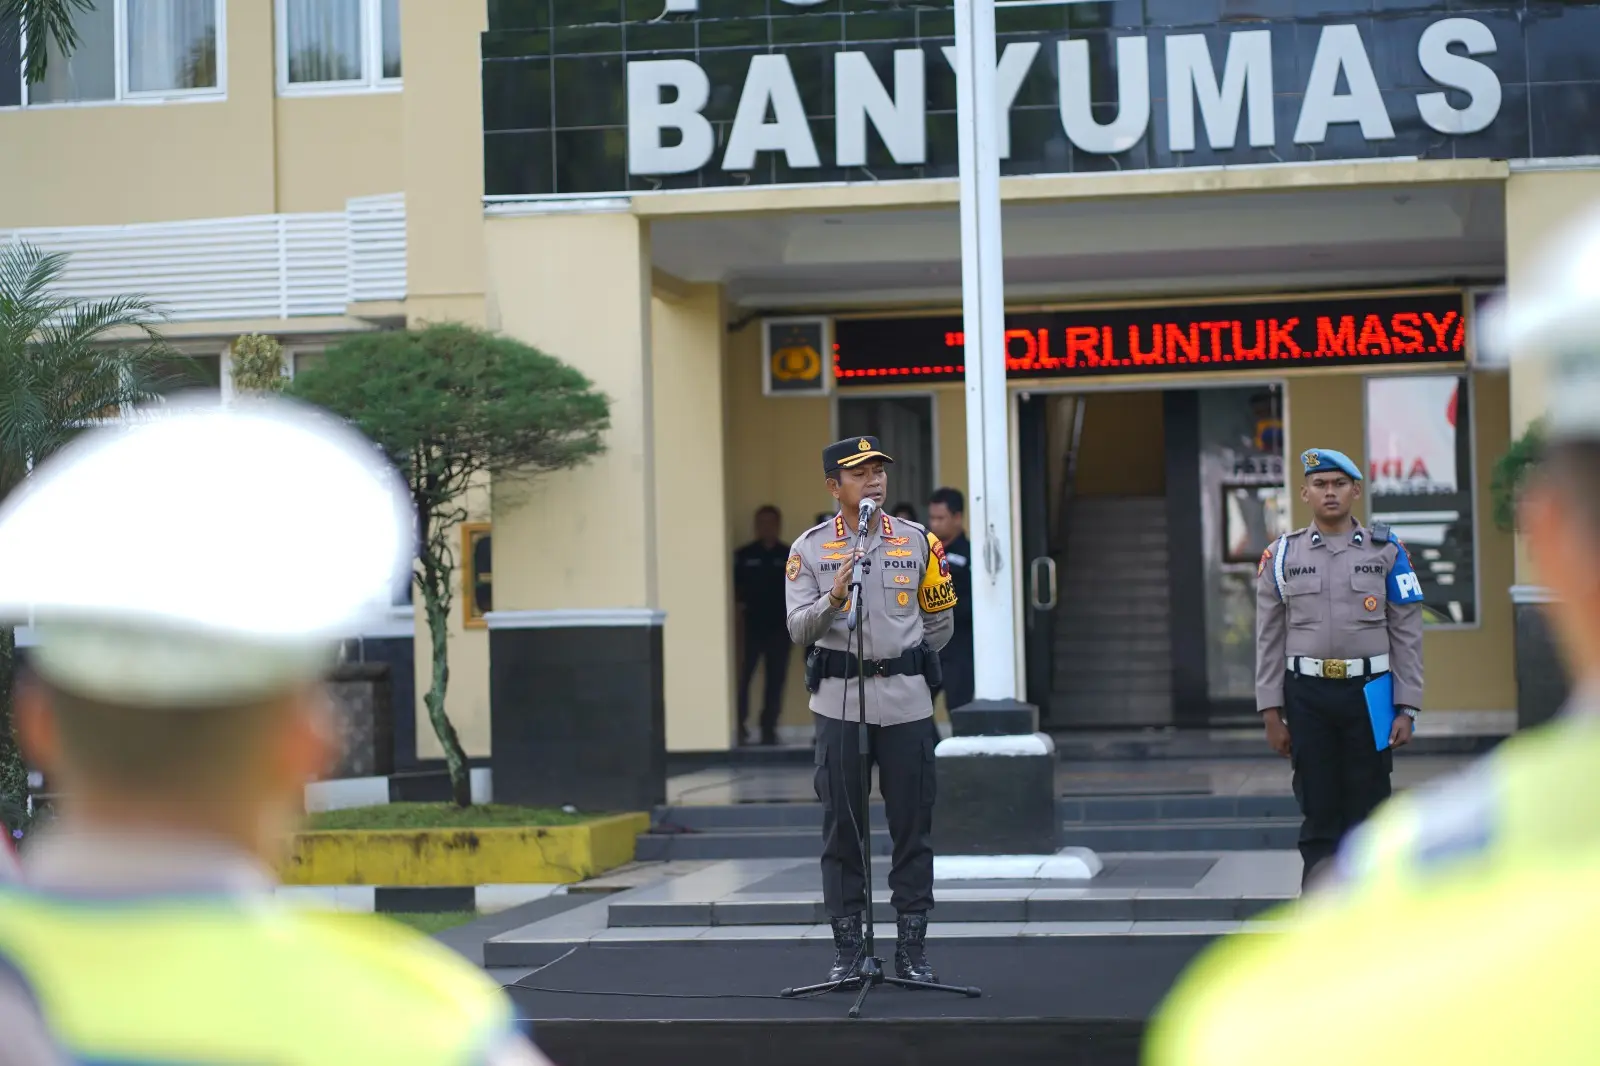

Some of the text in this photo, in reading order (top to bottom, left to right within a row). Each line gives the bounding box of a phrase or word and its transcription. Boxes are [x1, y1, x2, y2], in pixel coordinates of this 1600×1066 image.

[628, 17, 1502, 175] BANYUMAS
[1129, 316, 1301, 365] UNTUK
[820, 563, 831, 572] ARI
[884, 560, 917, 569] POLRI
[1354, 565, 1383, 574] POLRI
[1289, 566, 1316, 577] IWAN
